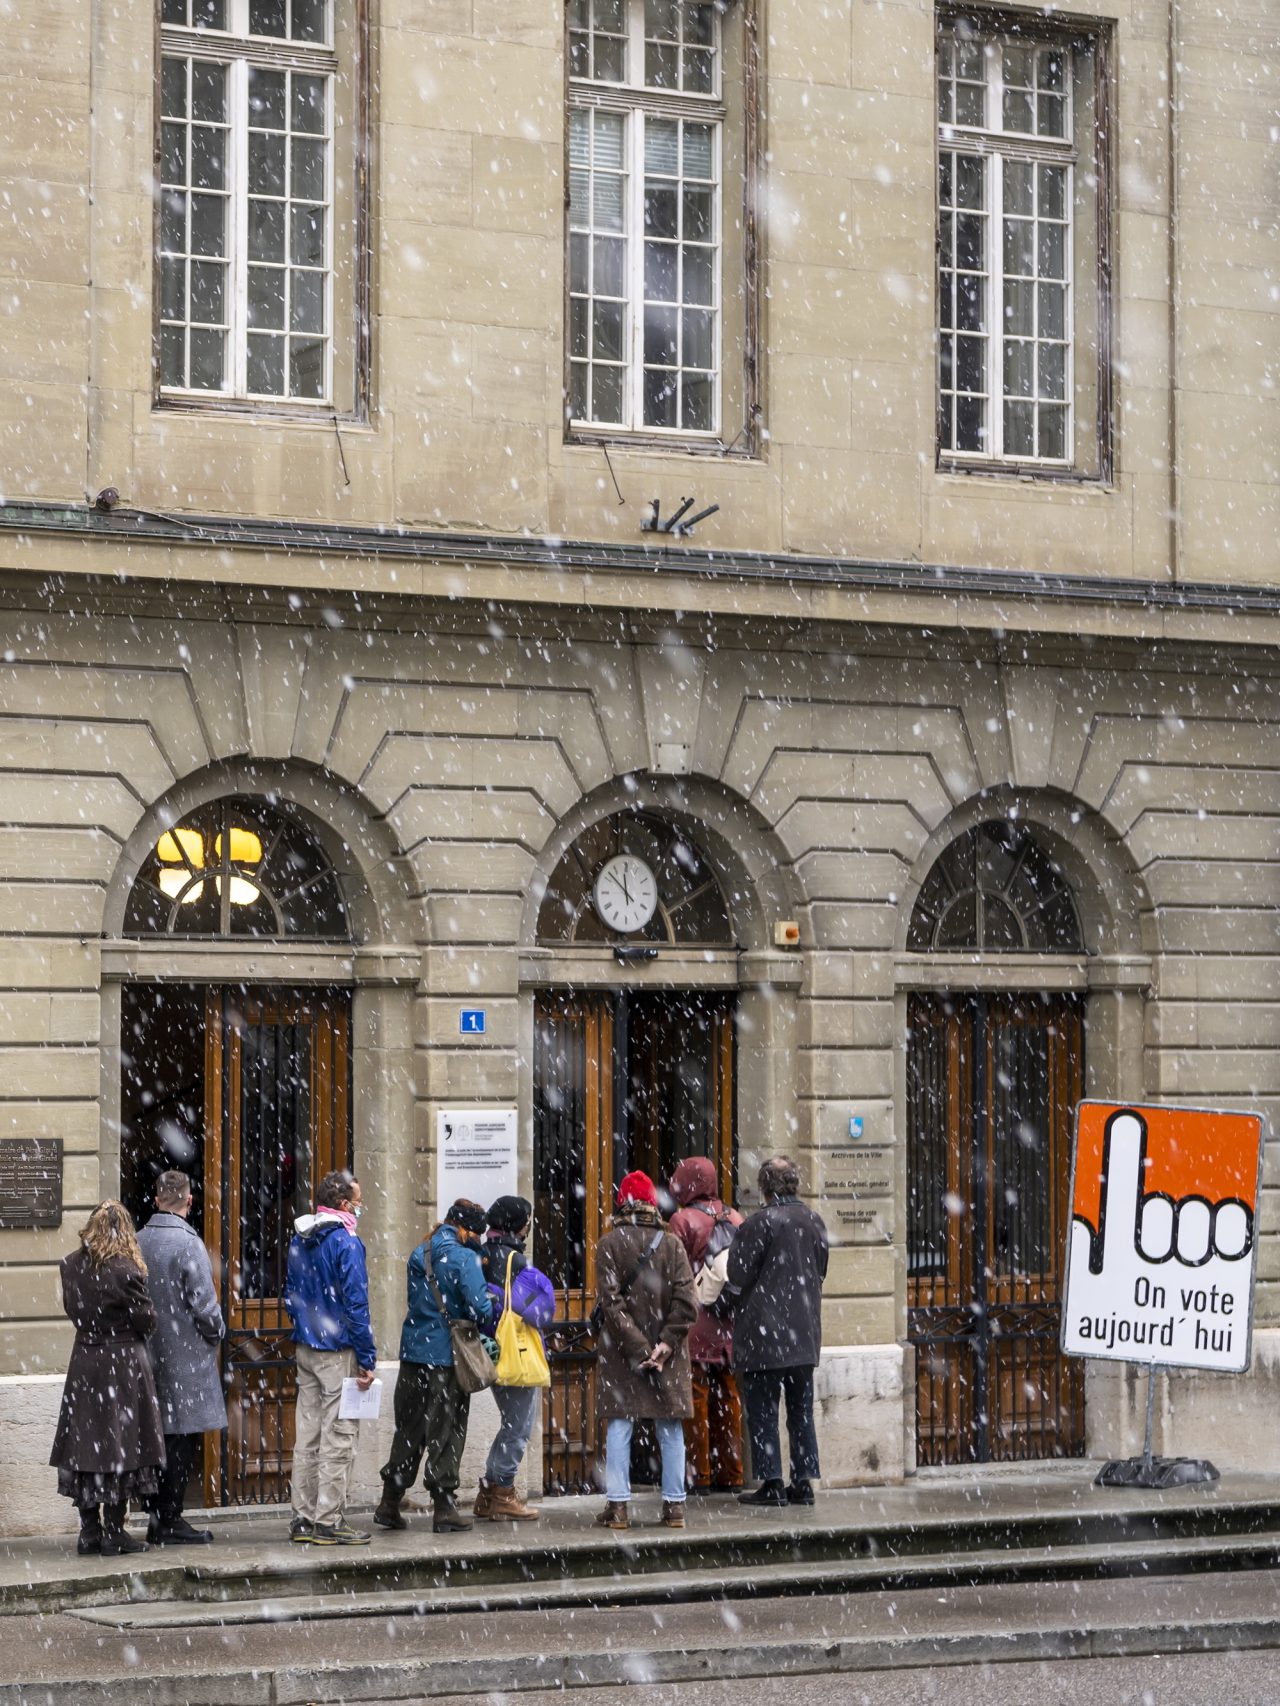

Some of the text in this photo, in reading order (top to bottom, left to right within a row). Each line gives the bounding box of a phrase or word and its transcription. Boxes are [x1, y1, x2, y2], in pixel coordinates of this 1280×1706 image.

[468, 1014, 477, 1029] 1
[870, 1151, 882, 1159] Ville
[1134, 1276, 1235, 1316] On vote
